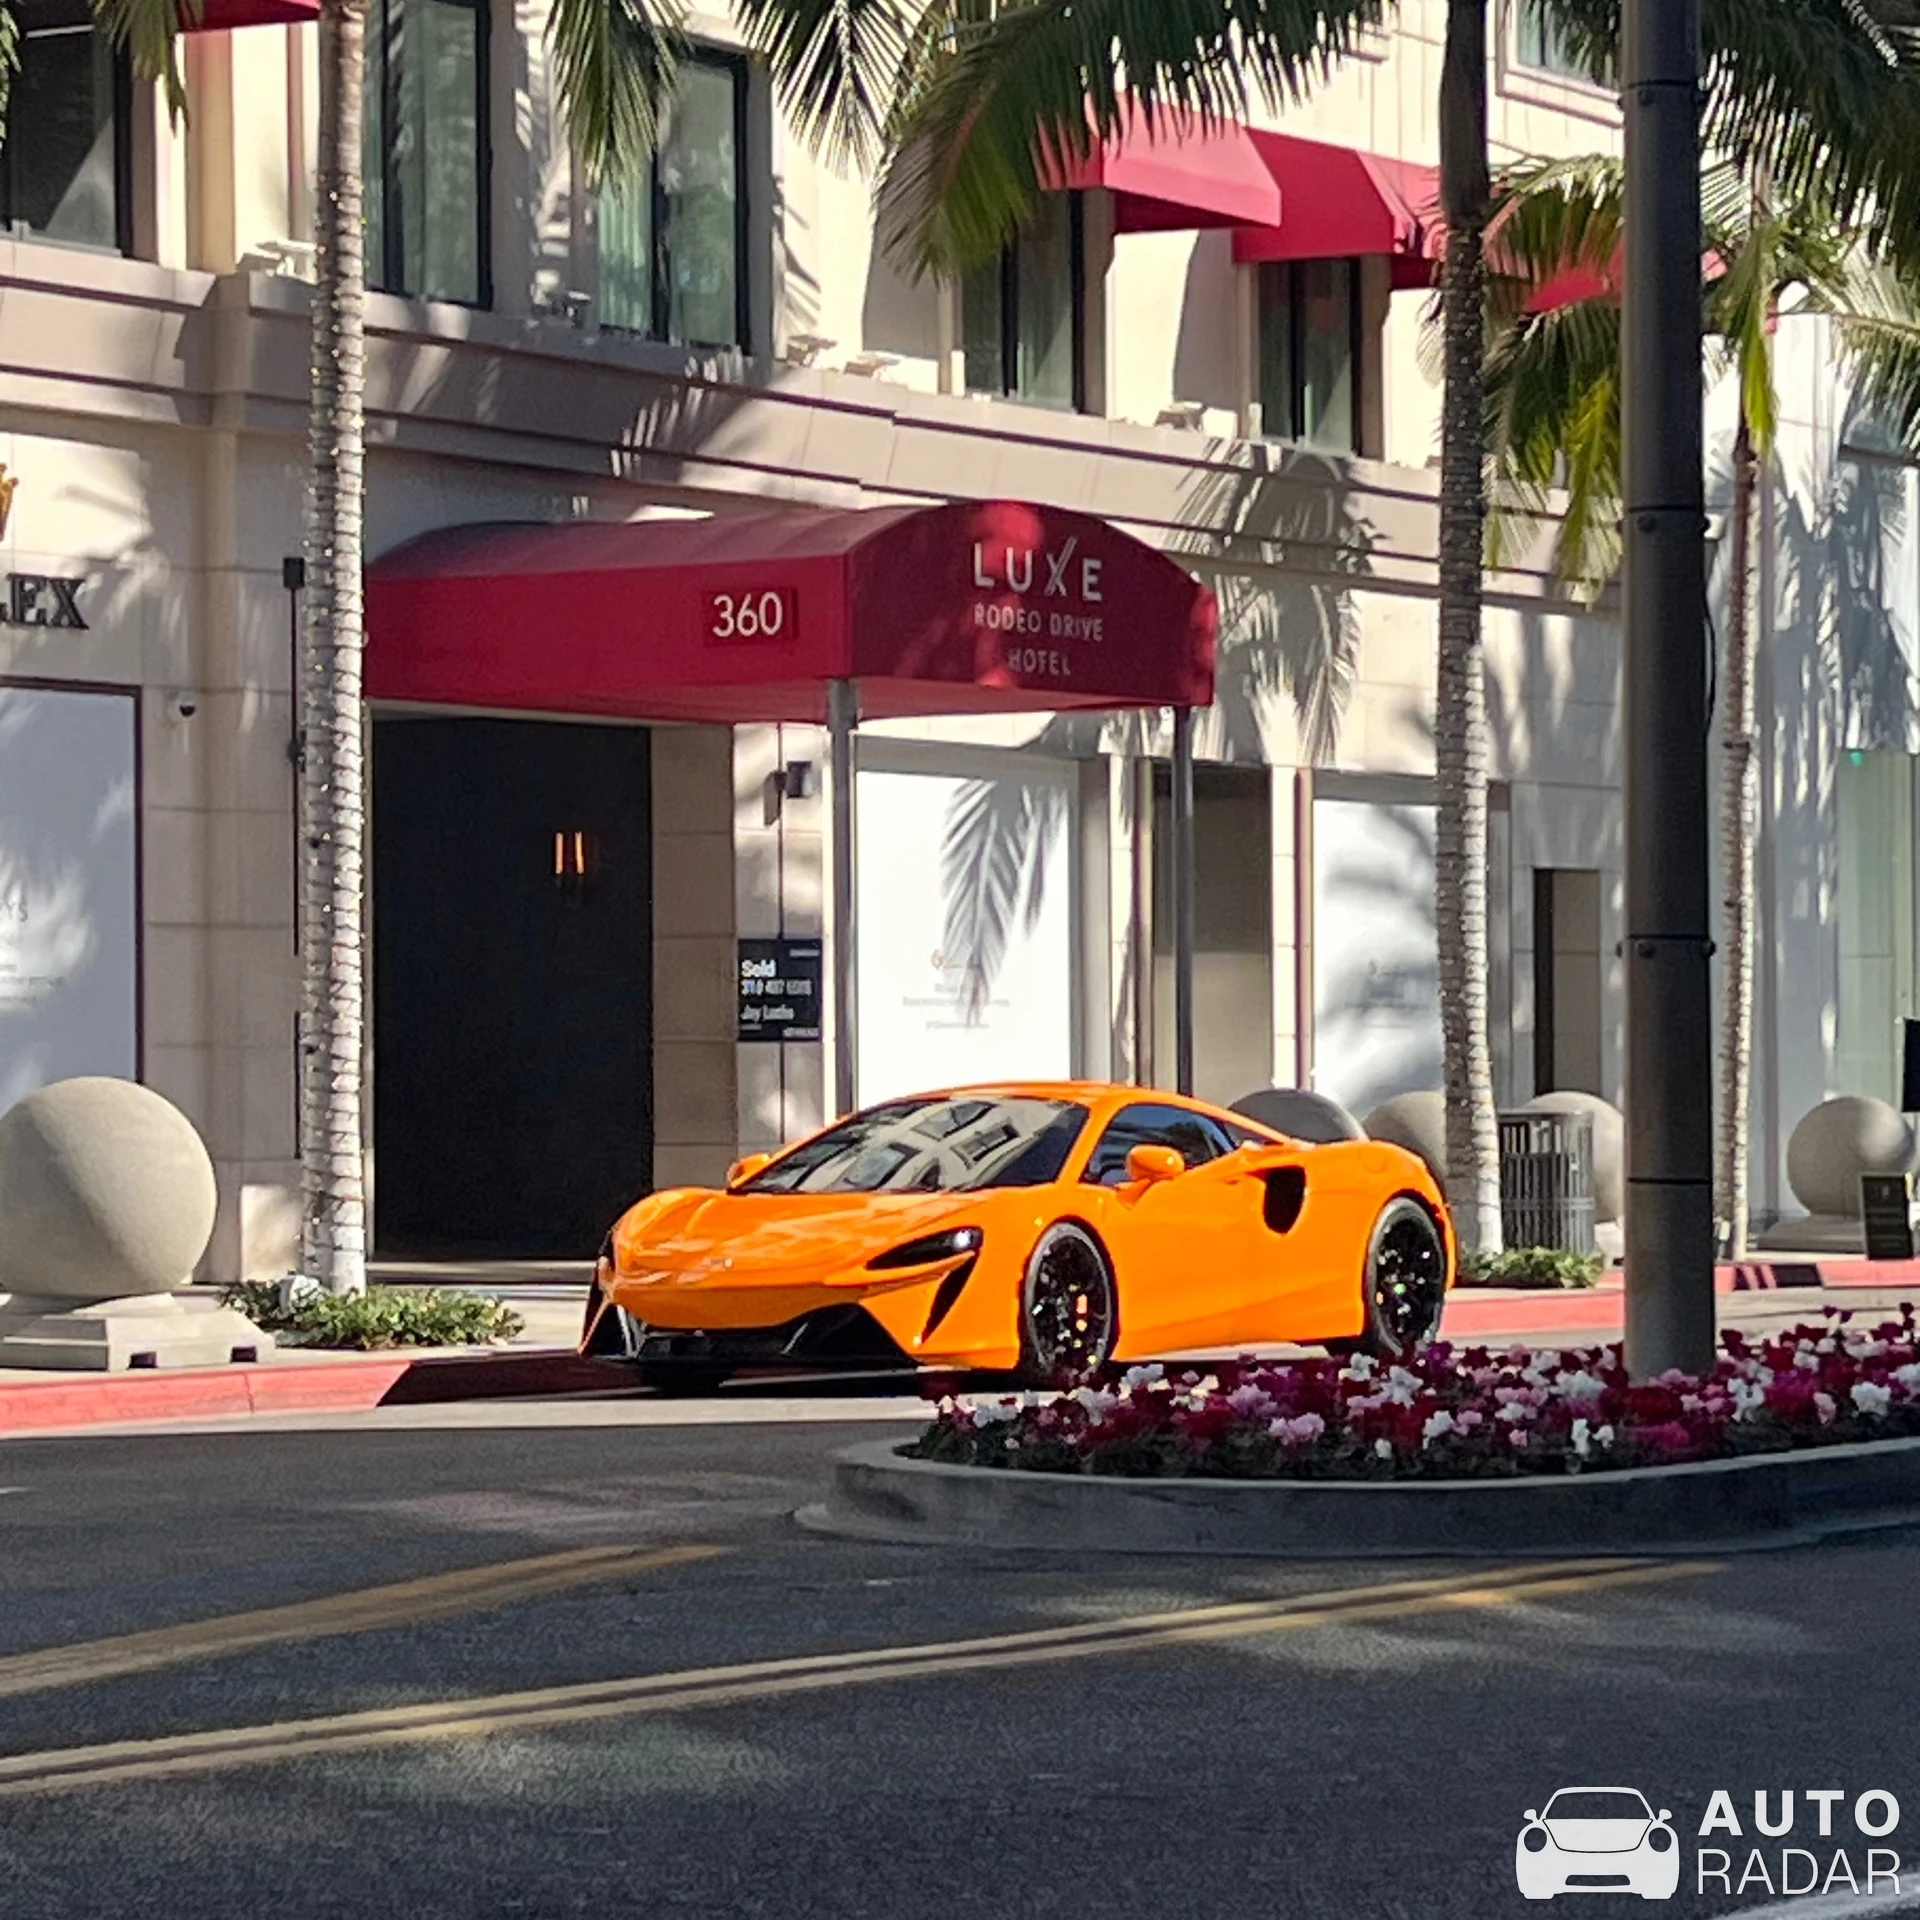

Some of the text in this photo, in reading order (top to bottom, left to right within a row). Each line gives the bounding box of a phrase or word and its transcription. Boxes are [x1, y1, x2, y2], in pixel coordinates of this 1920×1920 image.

[974, 535, 1102, 602] LUXE
[0, 573, 89, 630] EX
[712, 591, 783, 637] 360
[974, 601, 1103, 641] RODEO DRIVE
[1008, 649, 1071, 676] HOTEL
